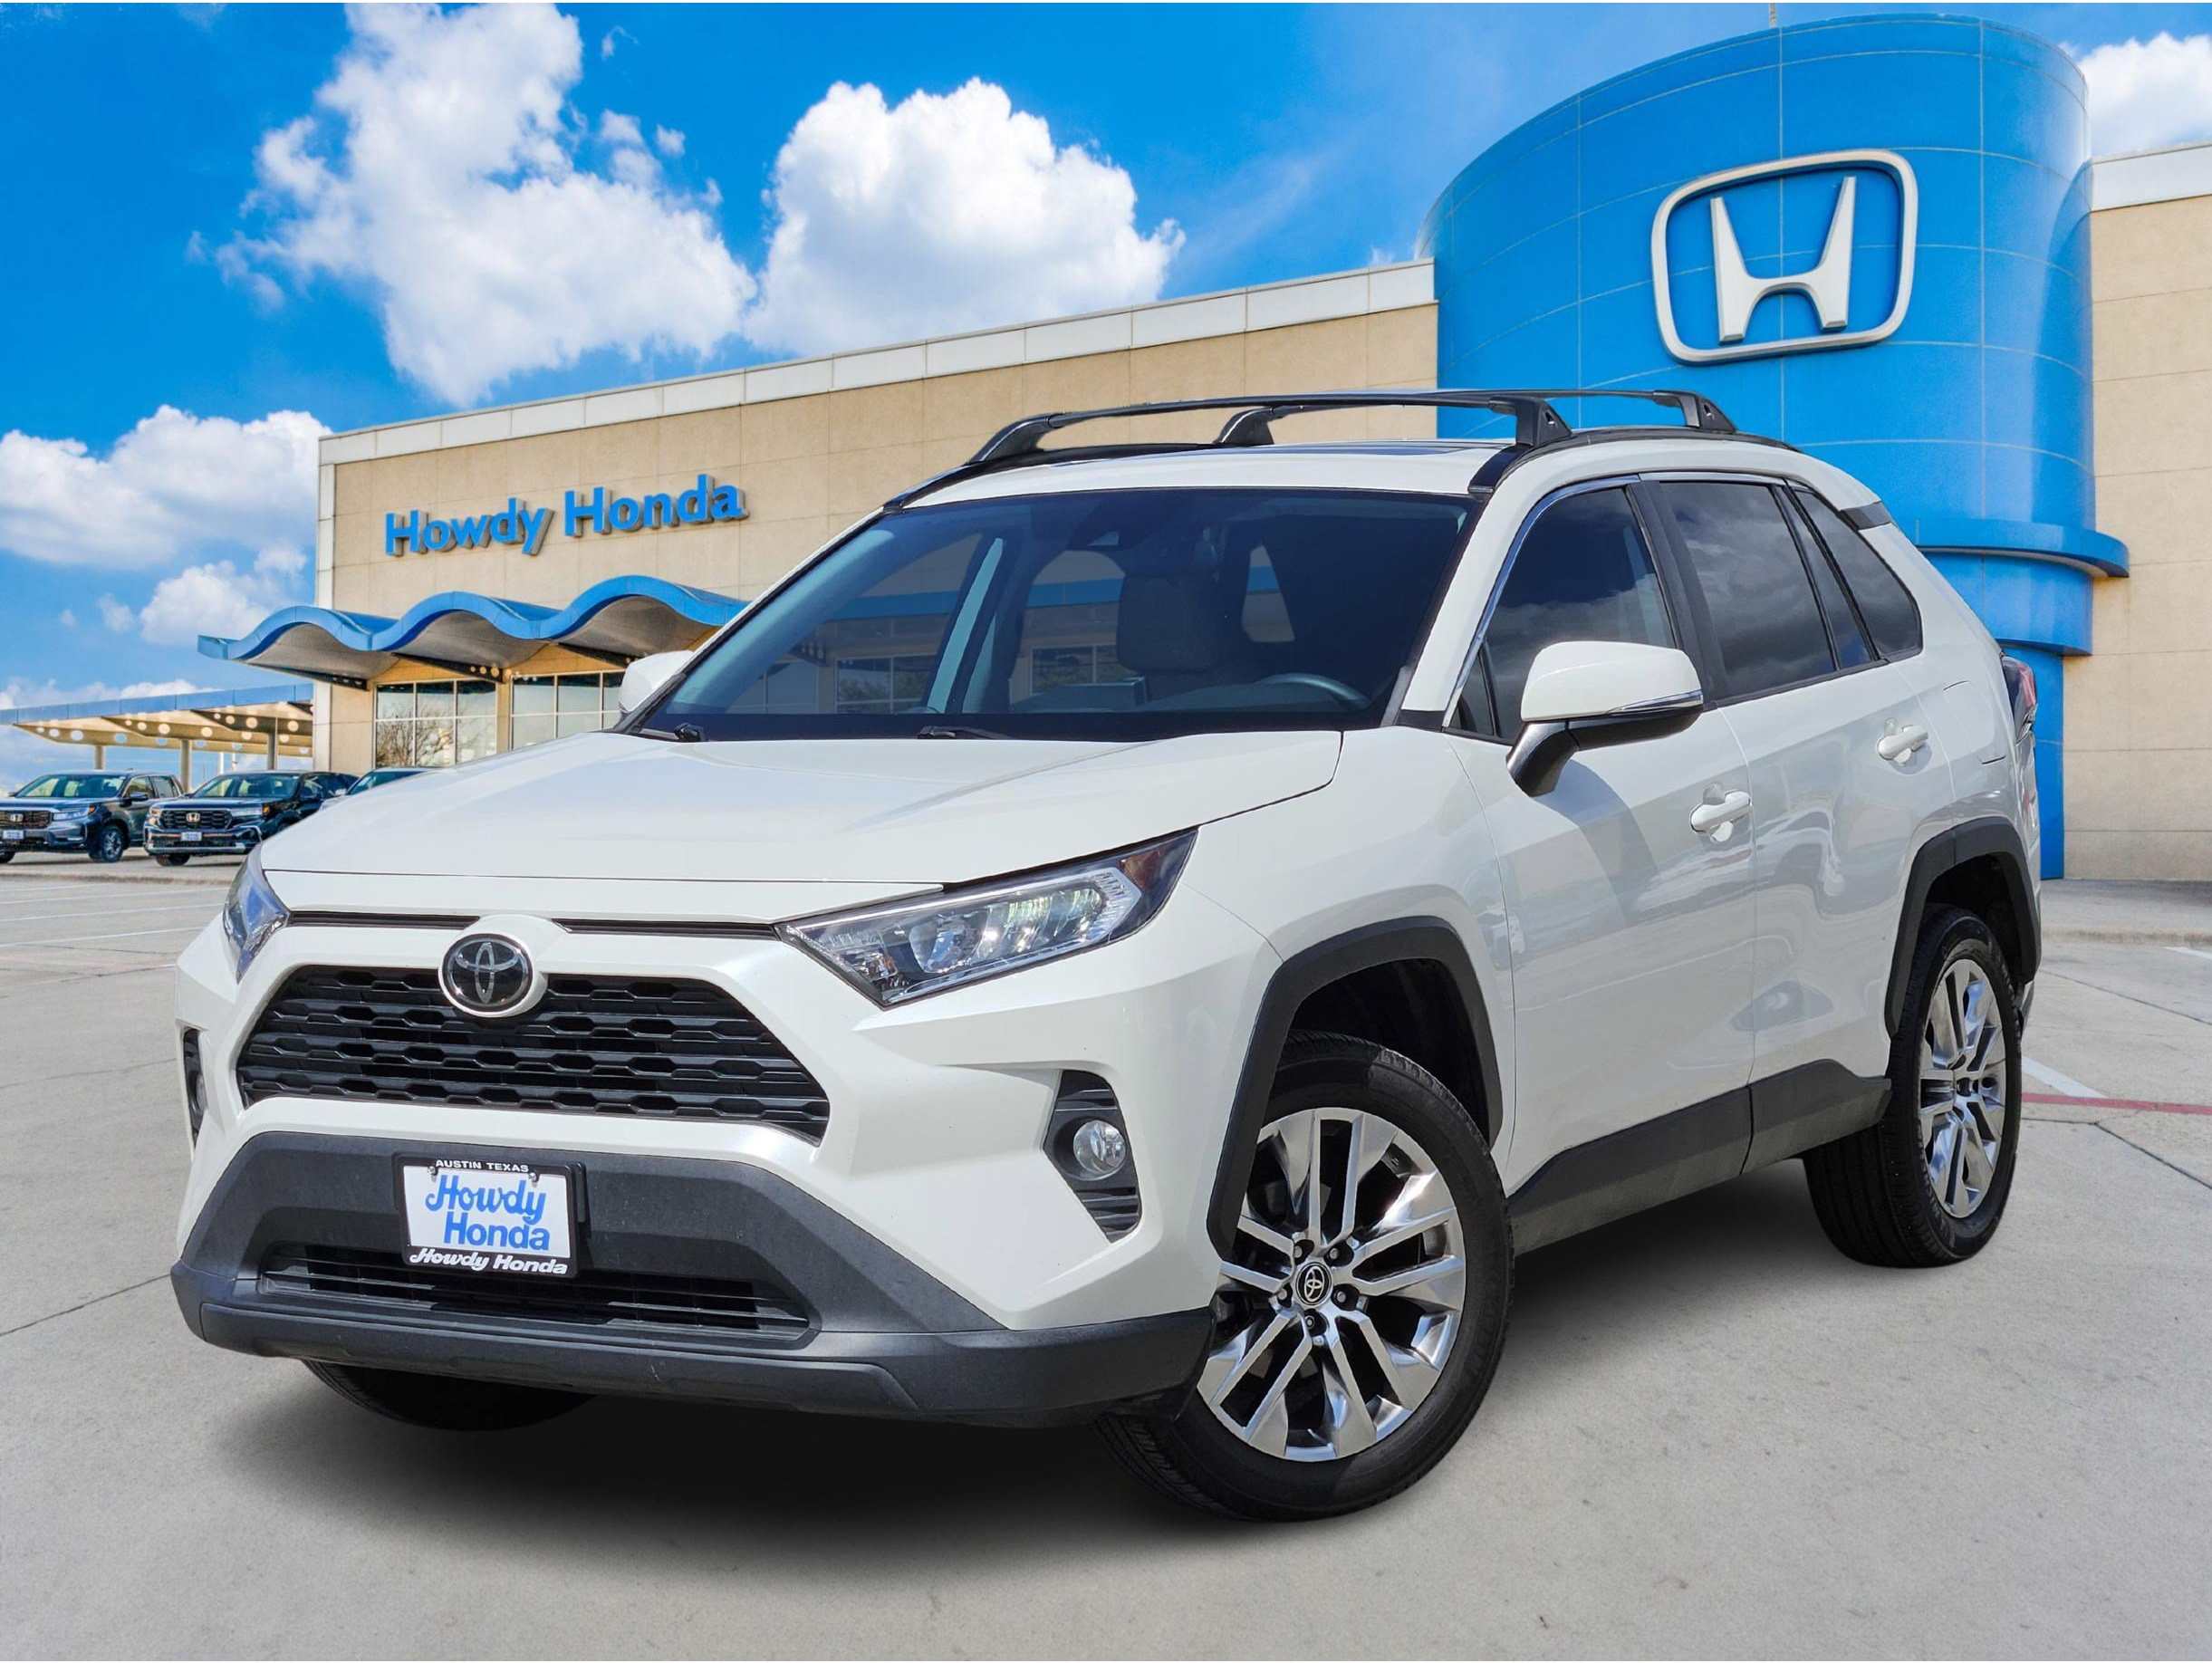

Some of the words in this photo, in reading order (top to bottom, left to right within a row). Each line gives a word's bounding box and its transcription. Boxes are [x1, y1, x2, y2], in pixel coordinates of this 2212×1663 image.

[385, 497, 553, 557] Howdy
[563, 474, 749, 538] Honda
[436, 1159, 482, 1169] AUSTIN
[486, 1162, 529, 1173] TEXAS
[425, 1174, 546, 1225] Howdy
[444, 1212, 551, 1251] Honda
[409, 1248, 489, 1271] Howdy
[492, 1254, 568, 1274] Honda
